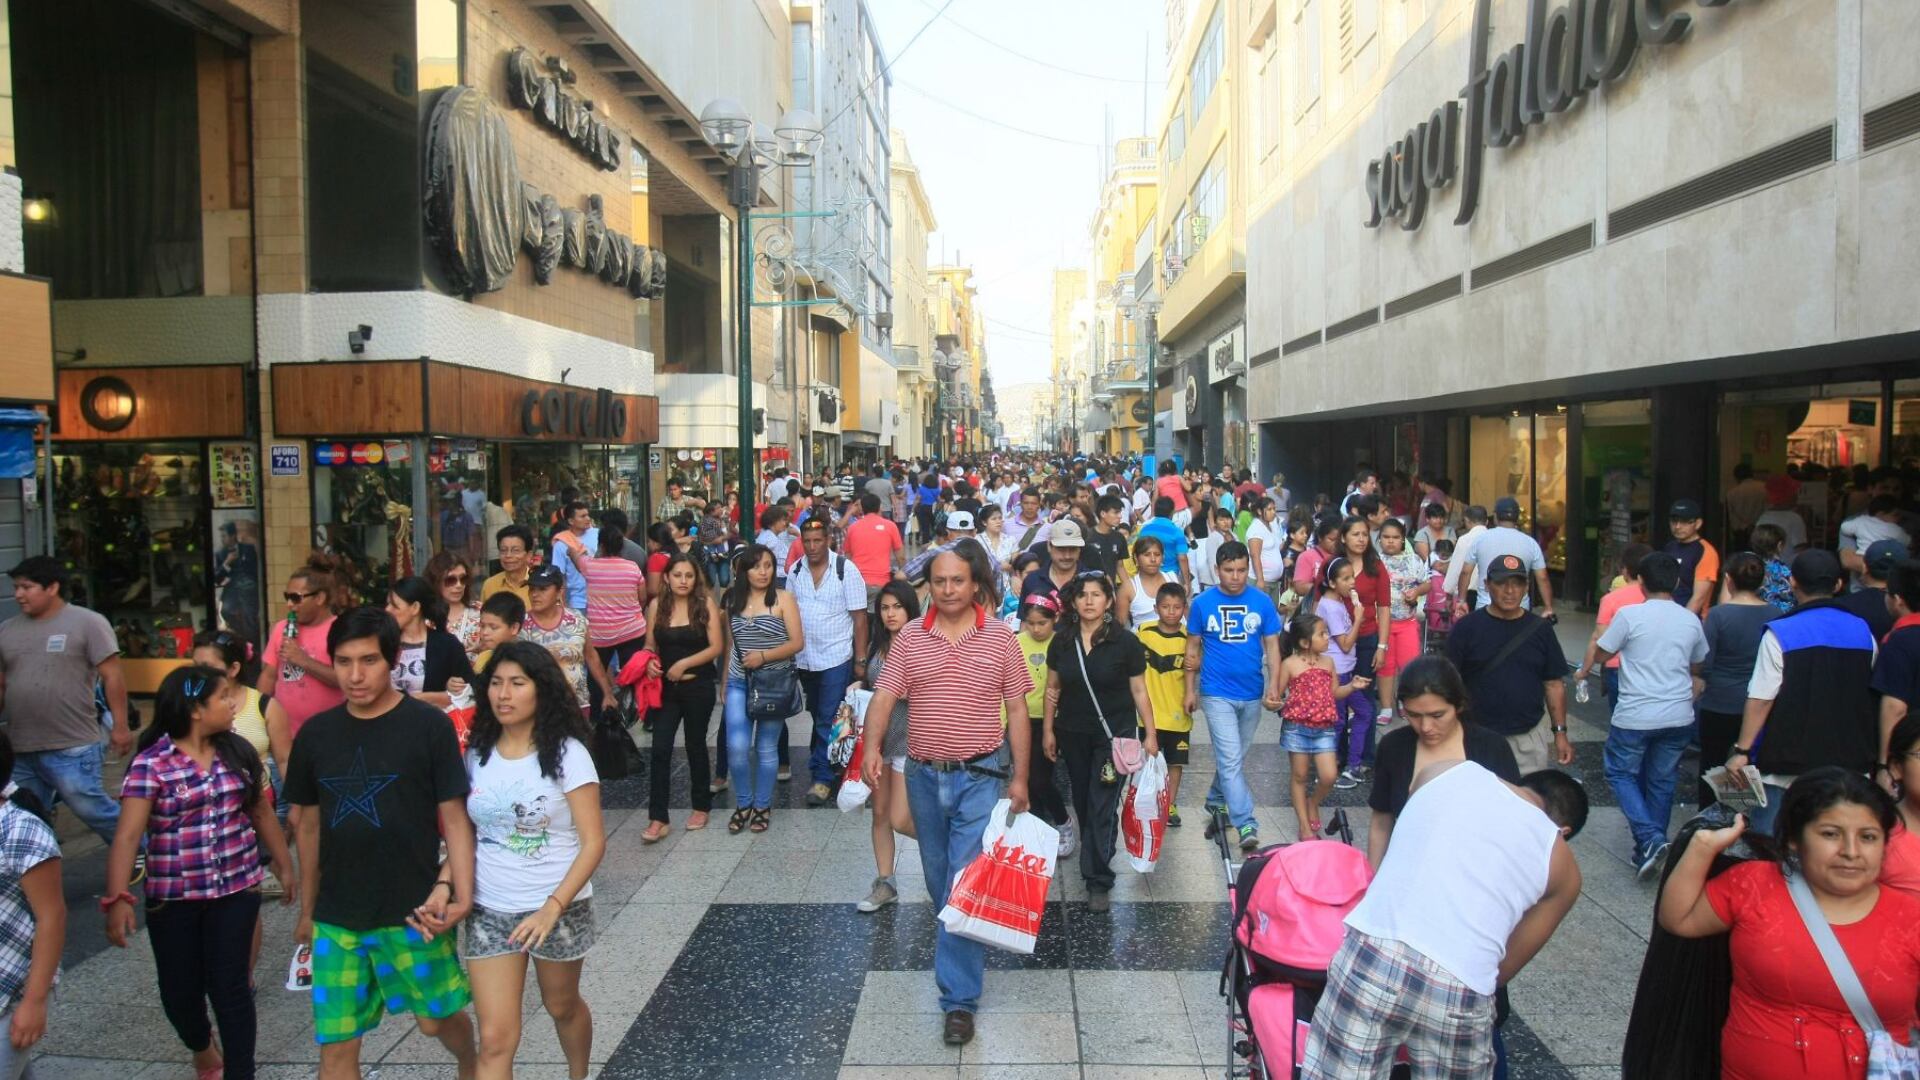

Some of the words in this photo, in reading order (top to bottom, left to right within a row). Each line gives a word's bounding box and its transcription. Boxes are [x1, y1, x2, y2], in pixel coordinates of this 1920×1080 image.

[1364, 101, 1458, 231] saga
[522, 387, 626, 437] corello
[273, 447, 298, 456] AFORO
[276, 456, 298, 467] 710
